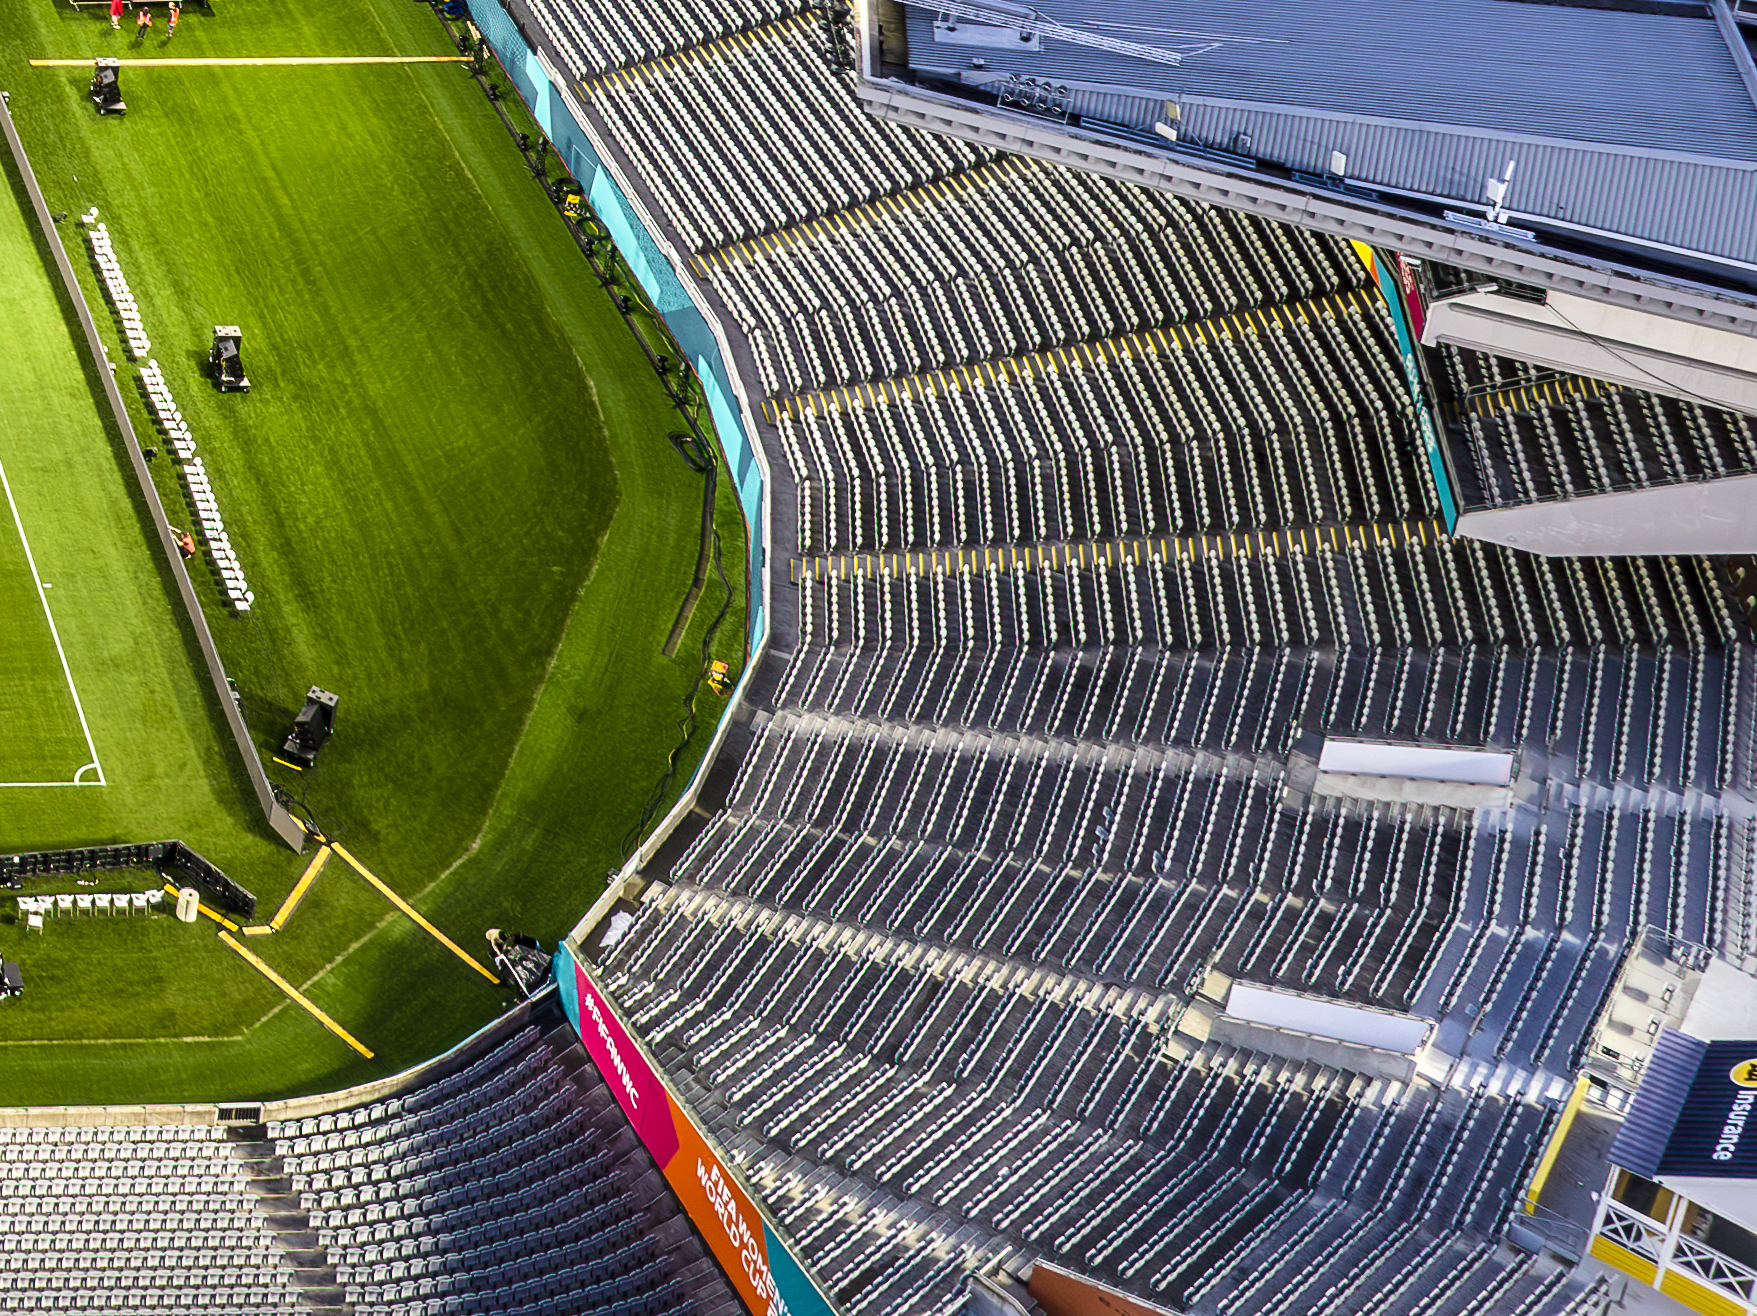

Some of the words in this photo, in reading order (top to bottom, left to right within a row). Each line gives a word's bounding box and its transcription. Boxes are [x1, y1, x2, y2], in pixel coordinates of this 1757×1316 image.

[584, 993, 640, 1110] #FIFAWWC
[1711, 1090, 1757, 1161] Insurance
[696, 1156, 740, 1248] WORLD
[741, 1249, 768, 1300] CUP
[710, 1164, 737, 1222] FIFA
